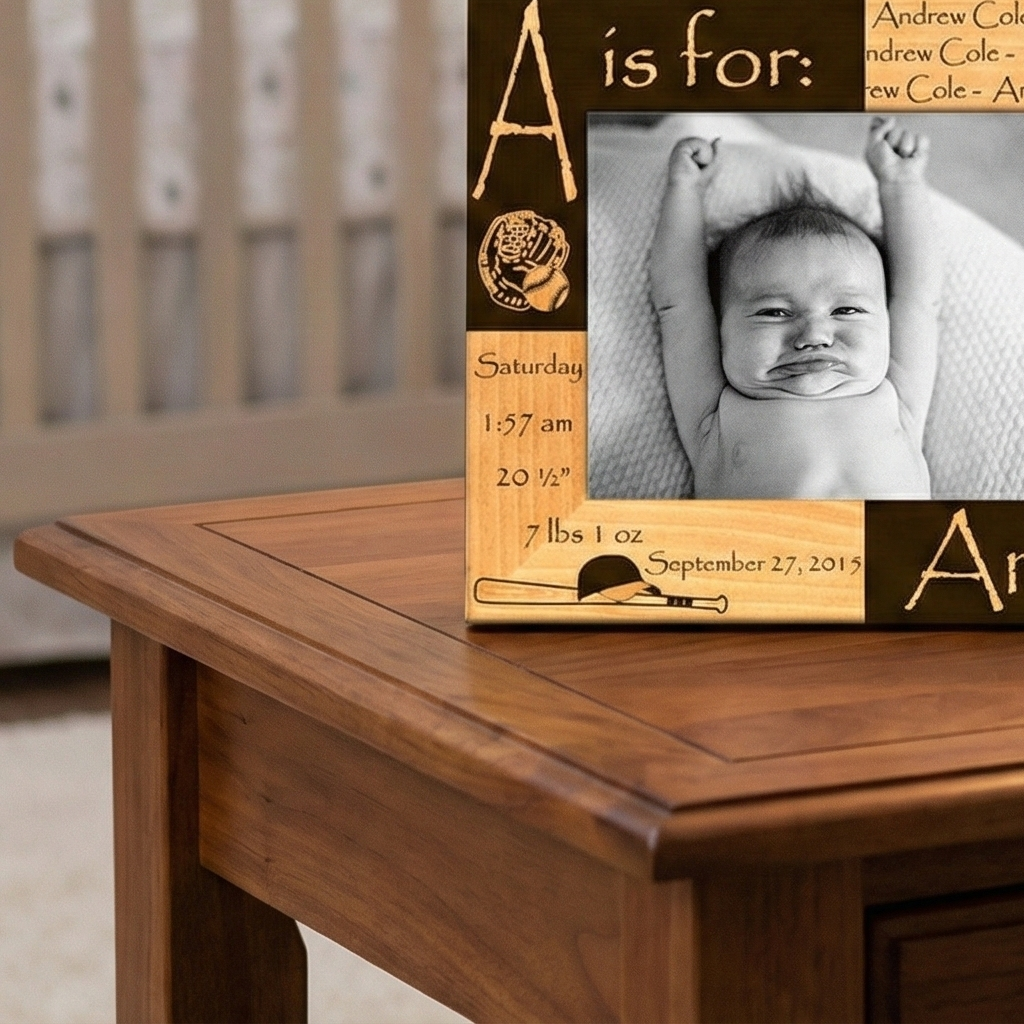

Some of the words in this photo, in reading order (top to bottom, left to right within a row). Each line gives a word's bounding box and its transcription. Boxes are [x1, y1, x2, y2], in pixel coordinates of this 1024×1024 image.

[872, 0, 966, 29] Andrew
[604, 26, 658, 88] is
[679, 9, 812, 88] for:
[474, 351, 583, 384] Saturday
[485, 413, 534, 438] 1:57
[540, 418, 573, 433] am
[496, 467, 530, 487] 20
[525, 524, 540, 548] 7
[548, 516, 584, 544] lbs
[614, 530, 643, 544] oz
[645, 550, 766, 581] September
[771, 555, 802, 576] 27,
[809, 555, 862, 574] 2015
